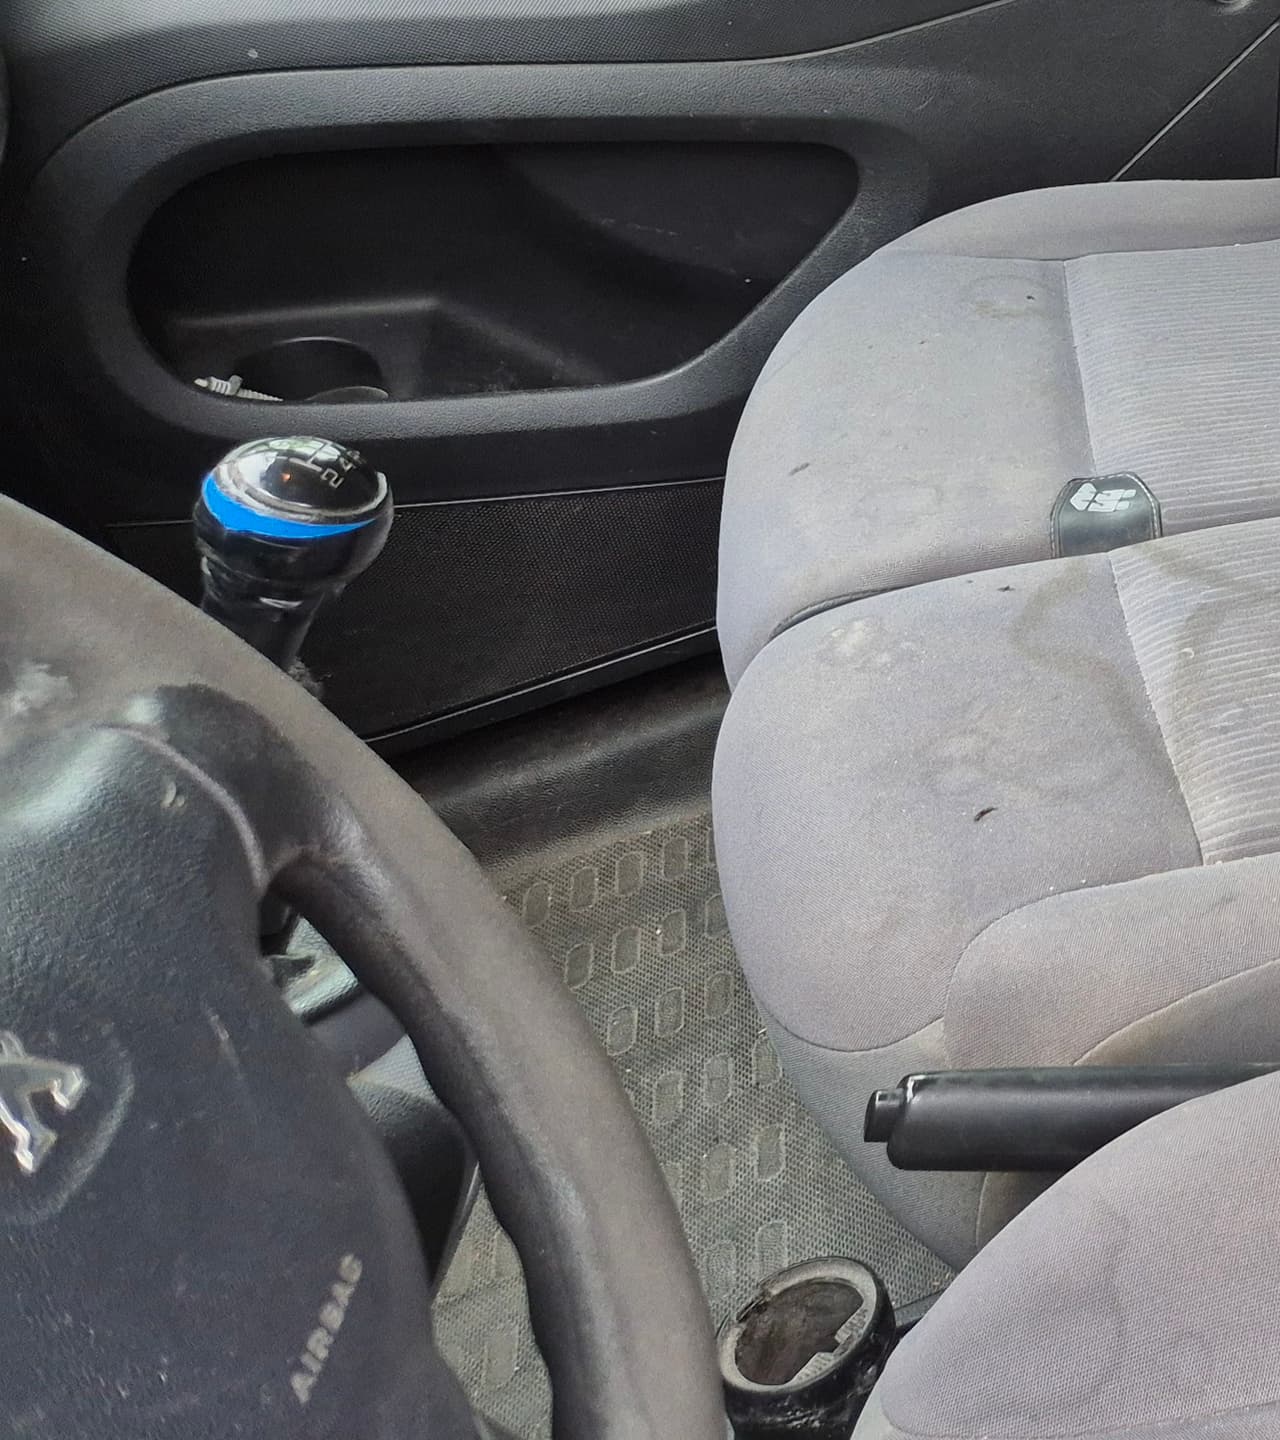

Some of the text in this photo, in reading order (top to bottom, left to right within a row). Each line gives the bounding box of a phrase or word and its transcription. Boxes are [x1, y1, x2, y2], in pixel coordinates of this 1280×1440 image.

[321, 468, 344, 488] 2
[340, 457, 357, 472] 4
[291, 1253, 363, 1403] AIRBAG
